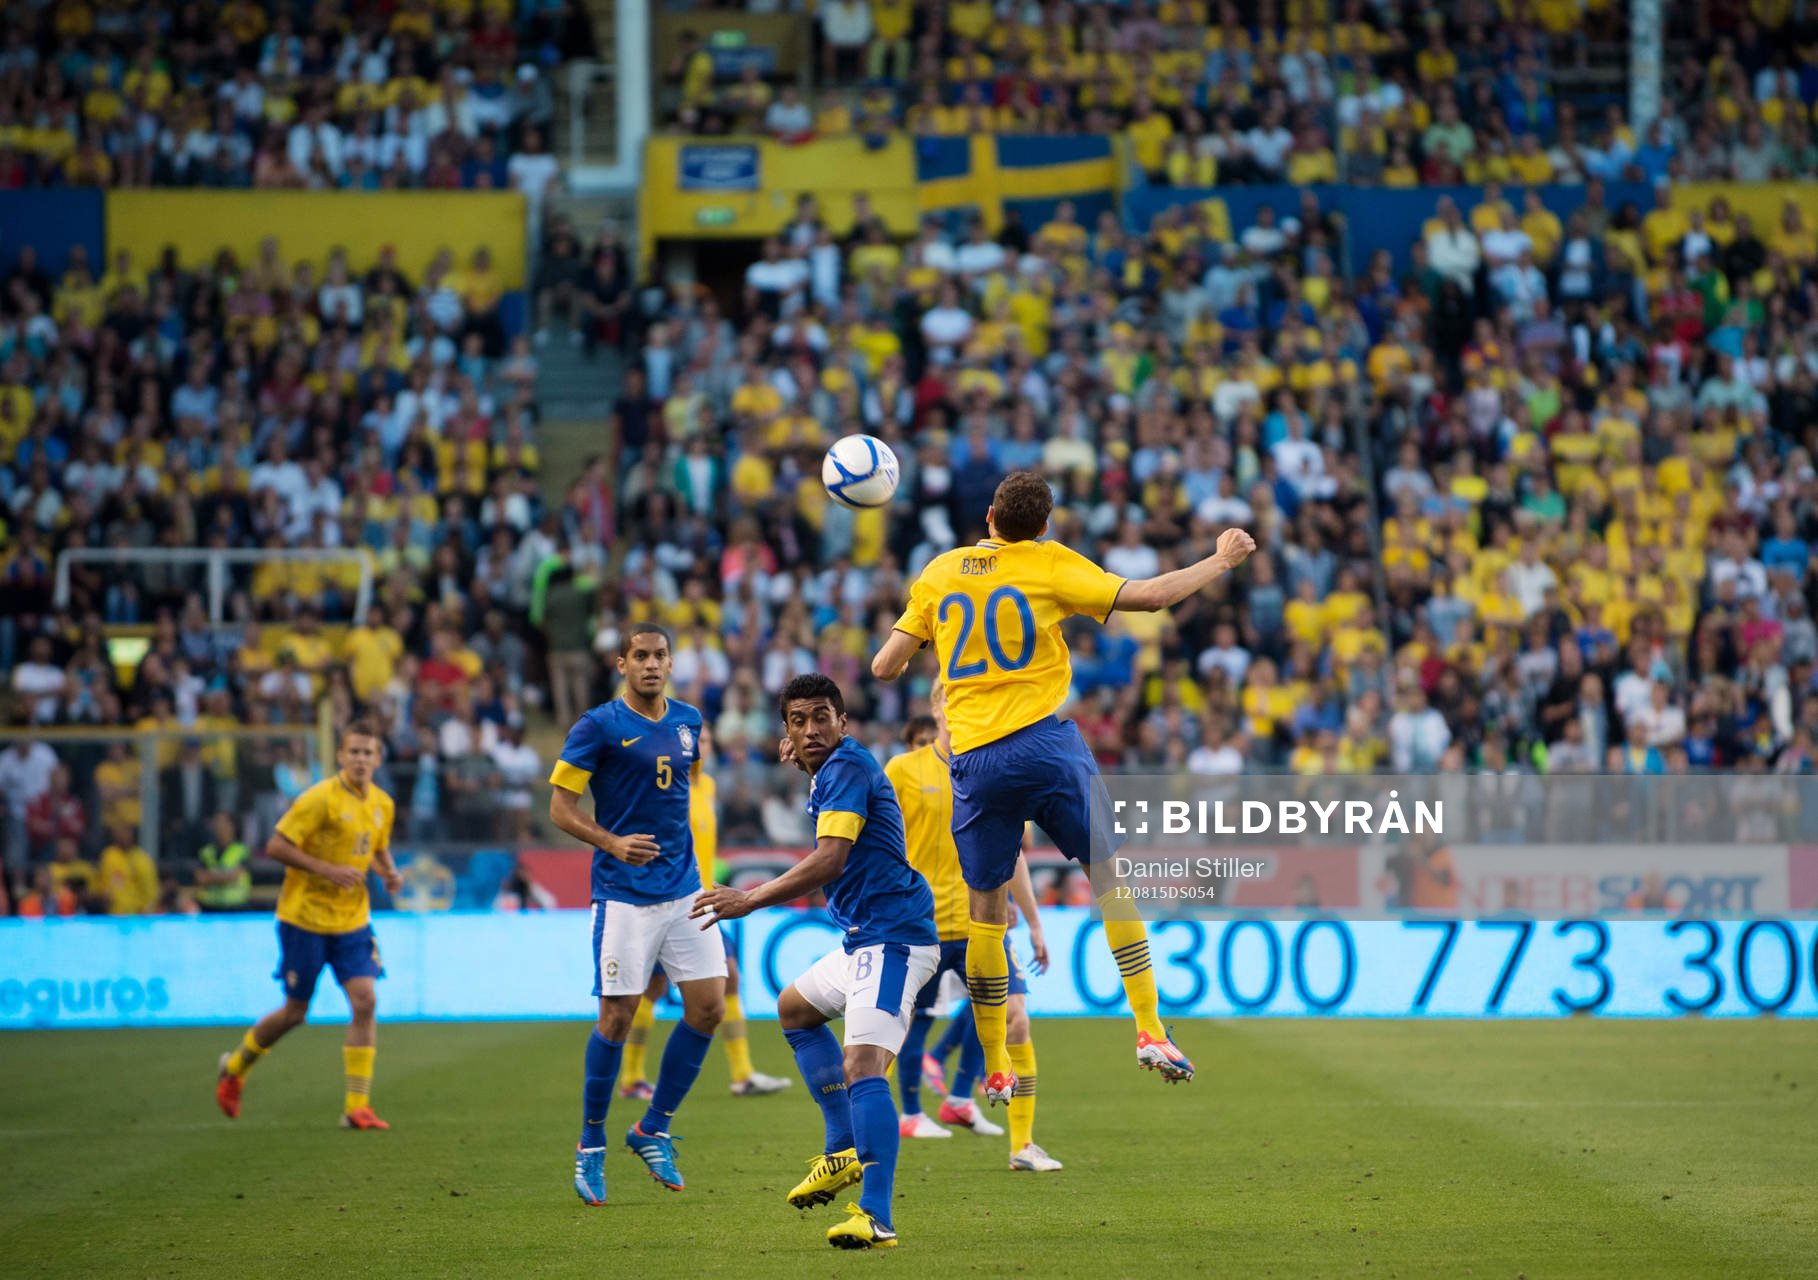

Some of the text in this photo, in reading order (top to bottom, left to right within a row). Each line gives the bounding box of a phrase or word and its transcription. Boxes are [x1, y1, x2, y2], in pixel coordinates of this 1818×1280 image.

[938, 584, 1037, 681] 20
[656, 755, 672, 789] 5
[855, 951, 873, 981] 8
[1071, 914, 1818, 1014] 0300 773 30
